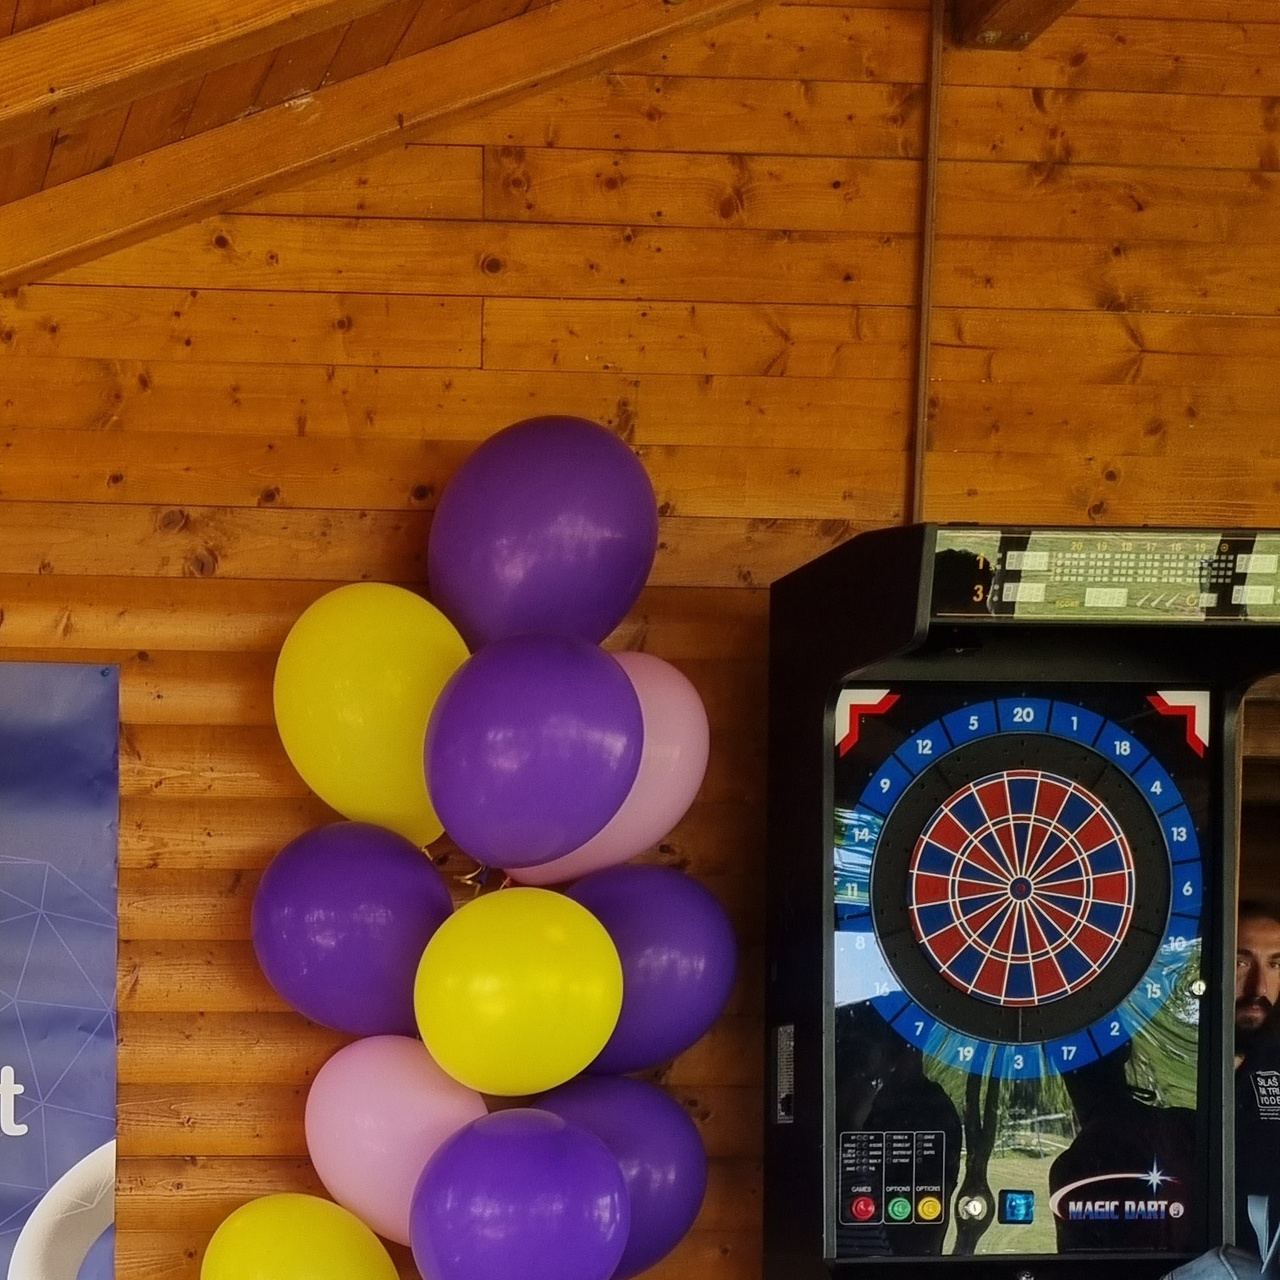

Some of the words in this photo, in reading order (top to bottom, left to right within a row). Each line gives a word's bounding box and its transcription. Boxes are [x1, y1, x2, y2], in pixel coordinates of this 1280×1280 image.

[1096, 542, 1108, 551] 19
[976, 552, 985, 570] 1
[972, 584, 984, 602] 3
[1012, 707, 1034, 723] 20
[968, 716, 978, 730] 5
[1071, 717, 1078, 730] 1
[916, 739, 932, 755] 12
[1114, 741, 1130, 755] 18
[880, 778, 891, 793] 9
[1150, 781, 1162, 795] 4
[854, 828, 870, 842] 14
[1171, 827, 1187, 842] 13
[1182, 881, 1193, 896] 6
[855, 936, 865, 950] 8
[874, 982, 890, 997] 16
[1146, 983, 1161, 997] 15
[915, 1021, 924, 1035] 7
[1110, 1022, 1120, 1036] 2
[958, 1047, 974, 1062] 19
[1061, 1046, 1077, 1060] 17
[1013, 1055, 1024, 1070] 3
[1068, 1201, 1120, 1220] MAGIC
[1124, 1200, 1168, 1220] DART
